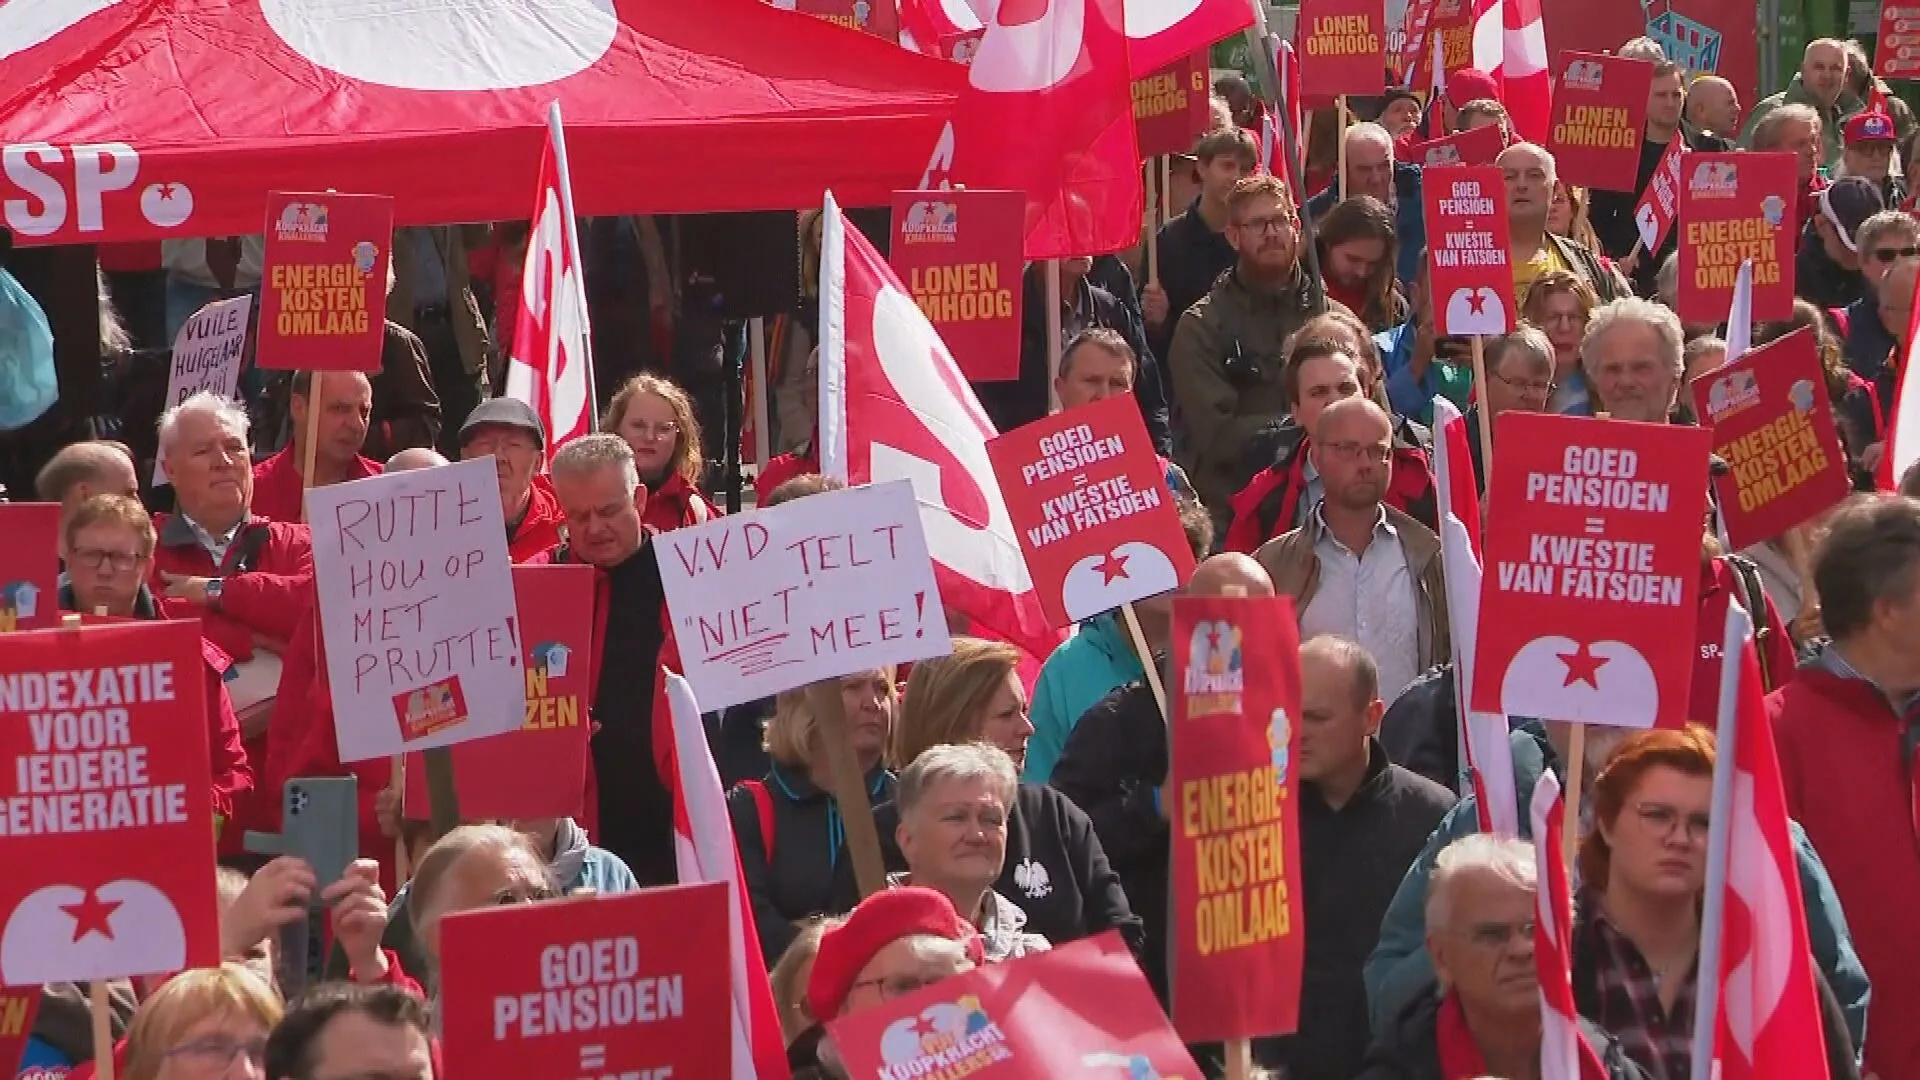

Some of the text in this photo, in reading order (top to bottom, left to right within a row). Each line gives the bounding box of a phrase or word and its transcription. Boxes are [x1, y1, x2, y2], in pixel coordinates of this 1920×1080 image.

[1306, 33, 1379, 55] OMHOOG
[1313, 14, 1370, 35] LONEN
[1130, 71, 1178, 101] ONEN
[1554, 123, 1636, 149] OMHOOG
[1565, 104, 1628, 128] LONEN
[1439, 198, 1494, 215] PENSIOEN
[1452, 181, 1480, 197] GOED
[1434, 249, 1506, 267] VAN FATSOEN
[1445, 232, 1494, 249] KWESTIE
[1697, 239, 1776, 268] KOSTEN
[911, 261, 998, 295] LONEN
[1695, 261, 1780, 289] OMLAG
[280, 287, 366, 311] KOSTEN
[915, 289, 1013, 324] MHOOG
[186, 309, 238, 341] VUILE
[277, 311, 369, 336] OMLAAG
[1022, 434, 1125, 486] PENSIOEN
[1039, 423, 1094, 458] GOED
[1732, 425, 1820, 487] KOSTEN
[1563, 445, 1638, 479] GOED
[1738, 447, 1829, 513] OMLAAG
[1041, 474, 1133, 522] KWESTIE
[1526, 472, 1670, 513] PENSIOEN
[336, 482, 482, 556] RUTTE
[1027, 487, 1161, 549] VAN FATSOEN
[785, 523, 904, 575] TELT
[1529, 534, 1655, 573] KWESTIE
[350, 550, 484, 599] HOU OP
[1498, 561, 1683, 607] VAN FATSOEN
[353, 594, 438, 643] MET
[810, 591, 925, 655] MEE!
[354, 615, 518, 694] PRUTTE!
[0, 662, 175, 713] NDEXATIE
[28, 707, 132, 752] VOOR
[16, 746, 149, 793] IEDERE
[1196, 822, 1284, 895] KOSTEN
[1195, 879, 1291, 956] OMLAAG
[540, 935, 640, 989] GOED
[493, 973, 684, 1041] PENSIOEN
